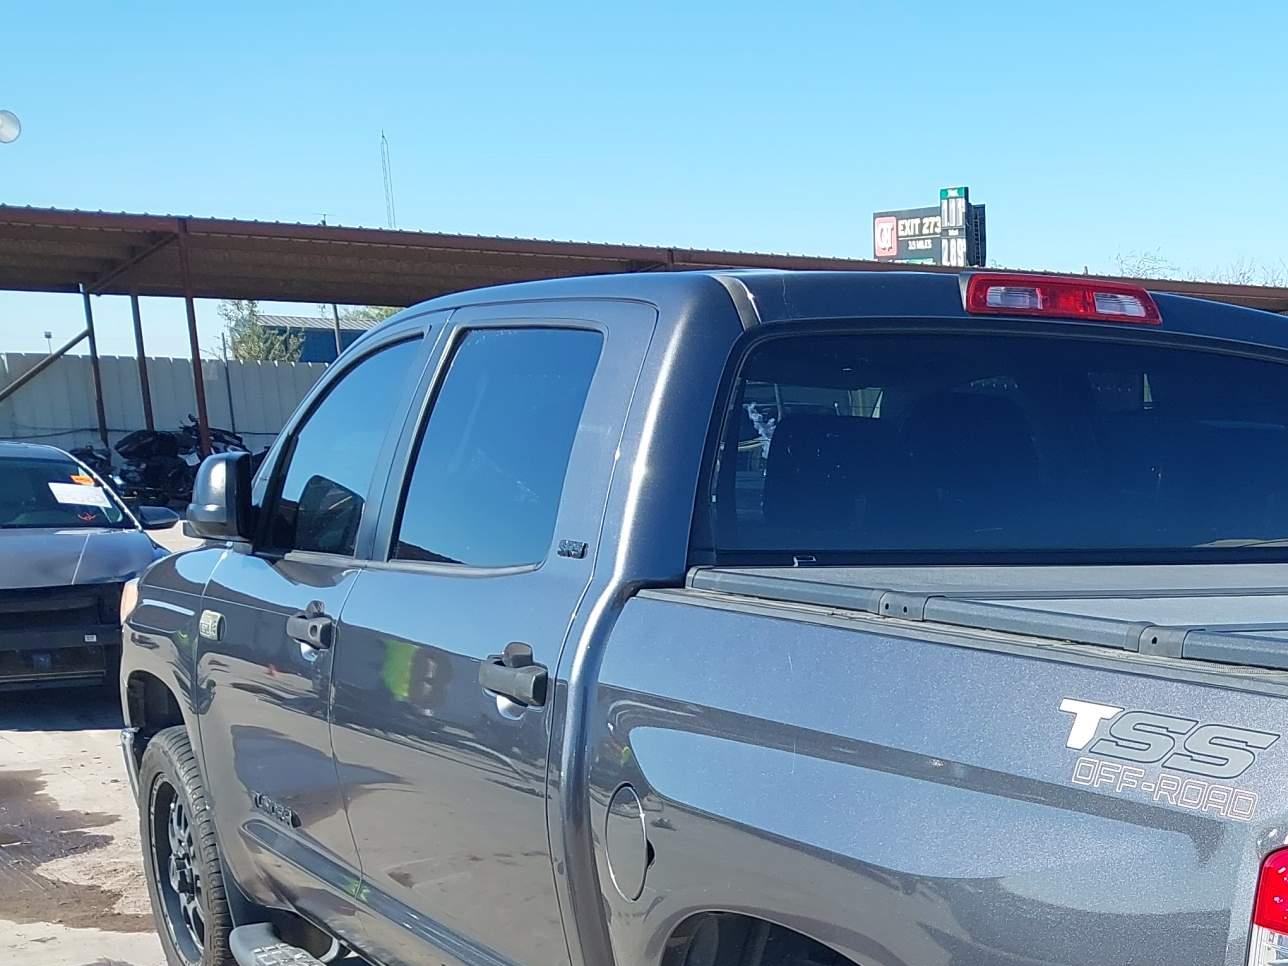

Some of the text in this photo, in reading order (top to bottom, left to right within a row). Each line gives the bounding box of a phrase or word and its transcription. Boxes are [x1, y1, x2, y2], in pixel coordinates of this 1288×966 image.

[898, 215, 942, 237] EXIT 273
[1072, 756, 1258, 821] OFF-ROAD
